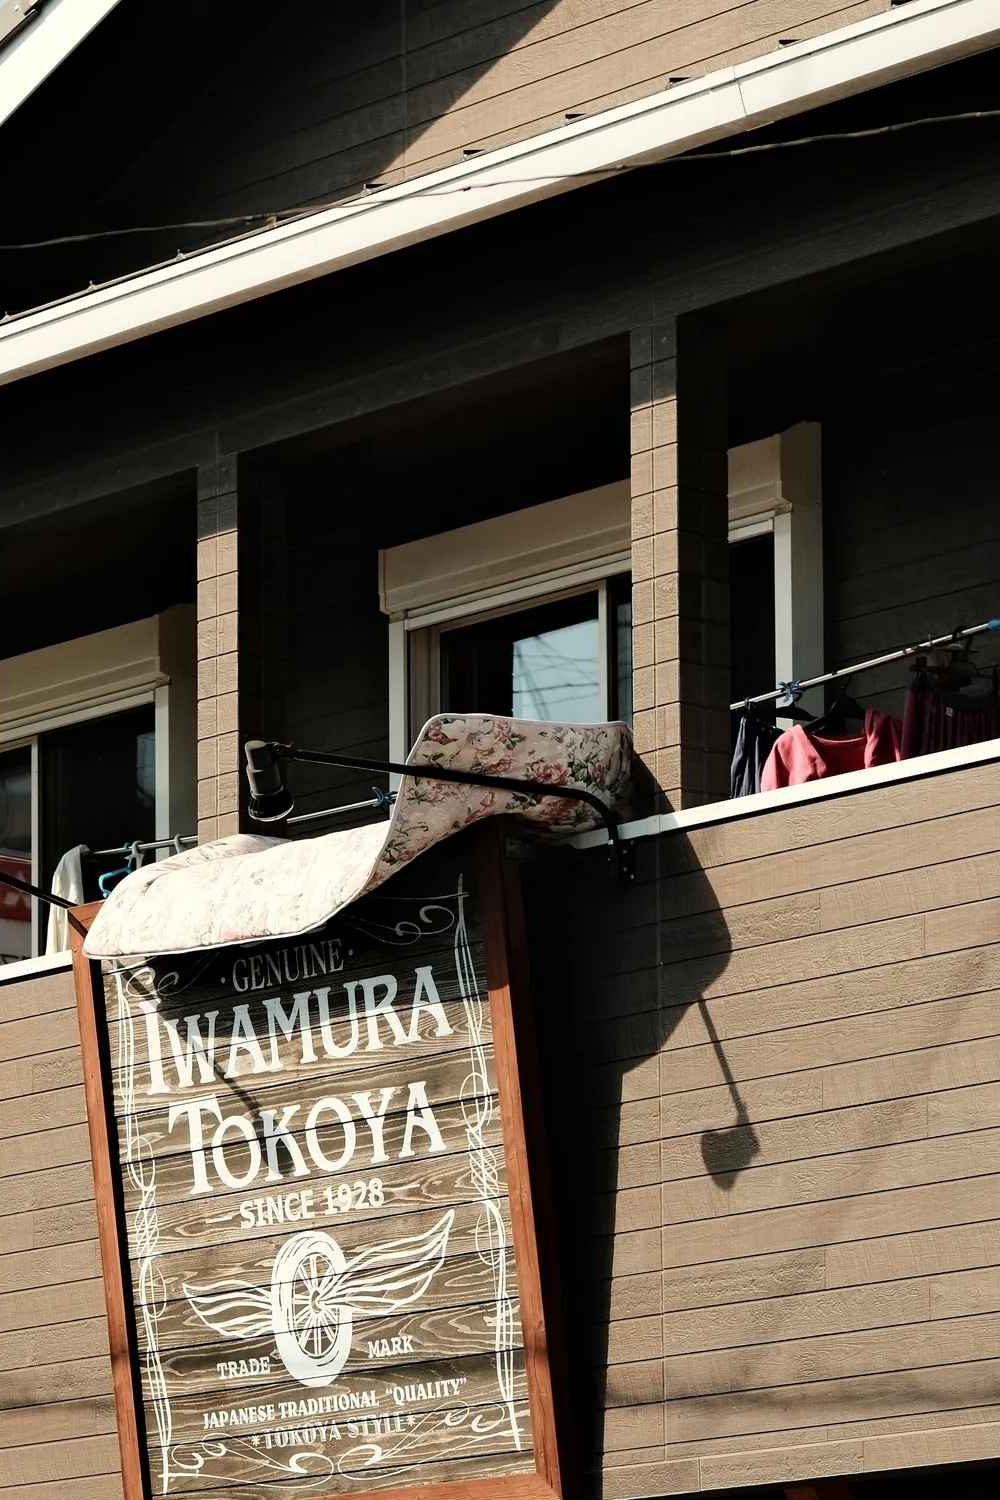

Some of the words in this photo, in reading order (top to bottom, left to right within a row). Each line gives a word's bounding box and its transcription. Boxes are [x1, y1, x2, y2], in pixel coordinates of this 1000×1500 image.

[232, 938, 344, 992] GENUINE
[138, 965, 454, 1096] IWAMURA
[168, 1081, 447, 1195] TOKOYA
[240, 1190, 315, 1229] SINCE
[323, 1178, 384, 1214] 1928
[216, 1356, 271, 1380] TRADE
[368, 1336, 415, 1358] MARK
[203, 1404, 275, 1430] JAPANESE
[278, 1390, 379, 1419] TRADITIONAL
